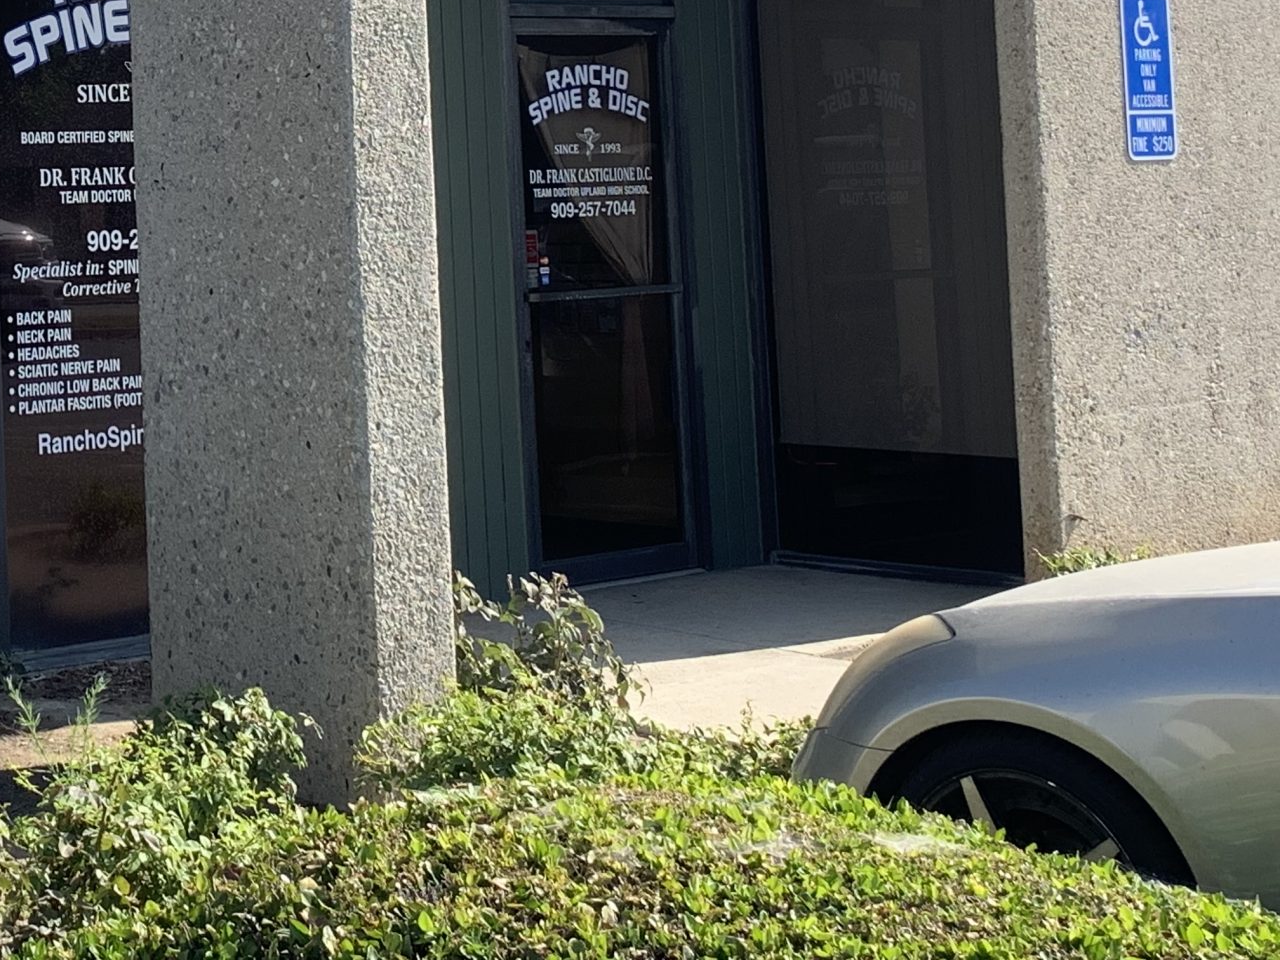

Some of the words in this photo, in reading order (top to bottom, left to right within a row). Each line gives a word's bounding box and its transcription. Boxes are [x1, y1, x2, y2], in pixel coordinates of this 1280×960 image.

[3, 0, 130, 75] SPINE
[1134, 48, 1162, 62] PARKING
[545, 64, 629, 91] RANCHO
[1140, 63, 1157, 77] ONLY
[76, 83, 130, 104] SINCE
[1143, 78, 1156, 92] VAN
[528, 89, 582, 126] SPINE
[588, 88, 601, 109] &
[608, 89, 650, 123] DISC
[1132, 94, 1169, 108] ACCESSIBLE
[1136, 117, 1168, 133] MINIMUM
[21, 132, 55, 144] BOARD
[57, 131, 105, 144] CERTIFIED
[107, 130, 134, 143] SPINE
[1132, 136, 1149, 153] FINE
[1152, 135, 1173, 153] $250
[554, 143, 580, 155] SINCE
[600, 143, 621, 153] 1993
[40, 168, 67, 187] DR.
[71, 167, 126, 186] FRANK
[529, 169, 545, 184] DR.
[547, 168, 577, 183] FRANK
[578, 167, 635, 182] CASTIGLIONE
[636, 166, 653, 180] D.C.
[60, 190, 88, 204] TEAM
[91, 189, 131, 203] DOCTOR
[533, 188, 552, 198] TEAM
[553, 187, 579, 197] DOCTOR
[580, 186, 606, 196] UPLAND
[607, 185, 623, 195] HIGH
[624, 184, 650, 195] SCHOOL
[551, 200, 636, 219] 909-257-7044
[13, 261, 83, 283] Specialist
[86, 261, 104, 276] in:
[108, 259, 139, 276] SPIN
[63, 279, 131, 297] Corrective
[16, 312, 46, 326] BACK
[47, 309, 72, 325] PAIN
[17, 330, 46, 344] NECK
[47, 328, 72, 342] PAIN
[18, 344, 80, 362] HEADACHES
[18, 363, 58, 379] SCIATIC
[61, 360, 95, 375] NERVE
[97, 358, 120, 373] PAIN
[18, 382, 65, 398] CHRONIC
[67, 379, 90, 394] LOW
[92, 376, 121, 392] BACK
[19, 399, 65, 416] PLANTAR
[67, 394, 112, 411] FASCITIS
